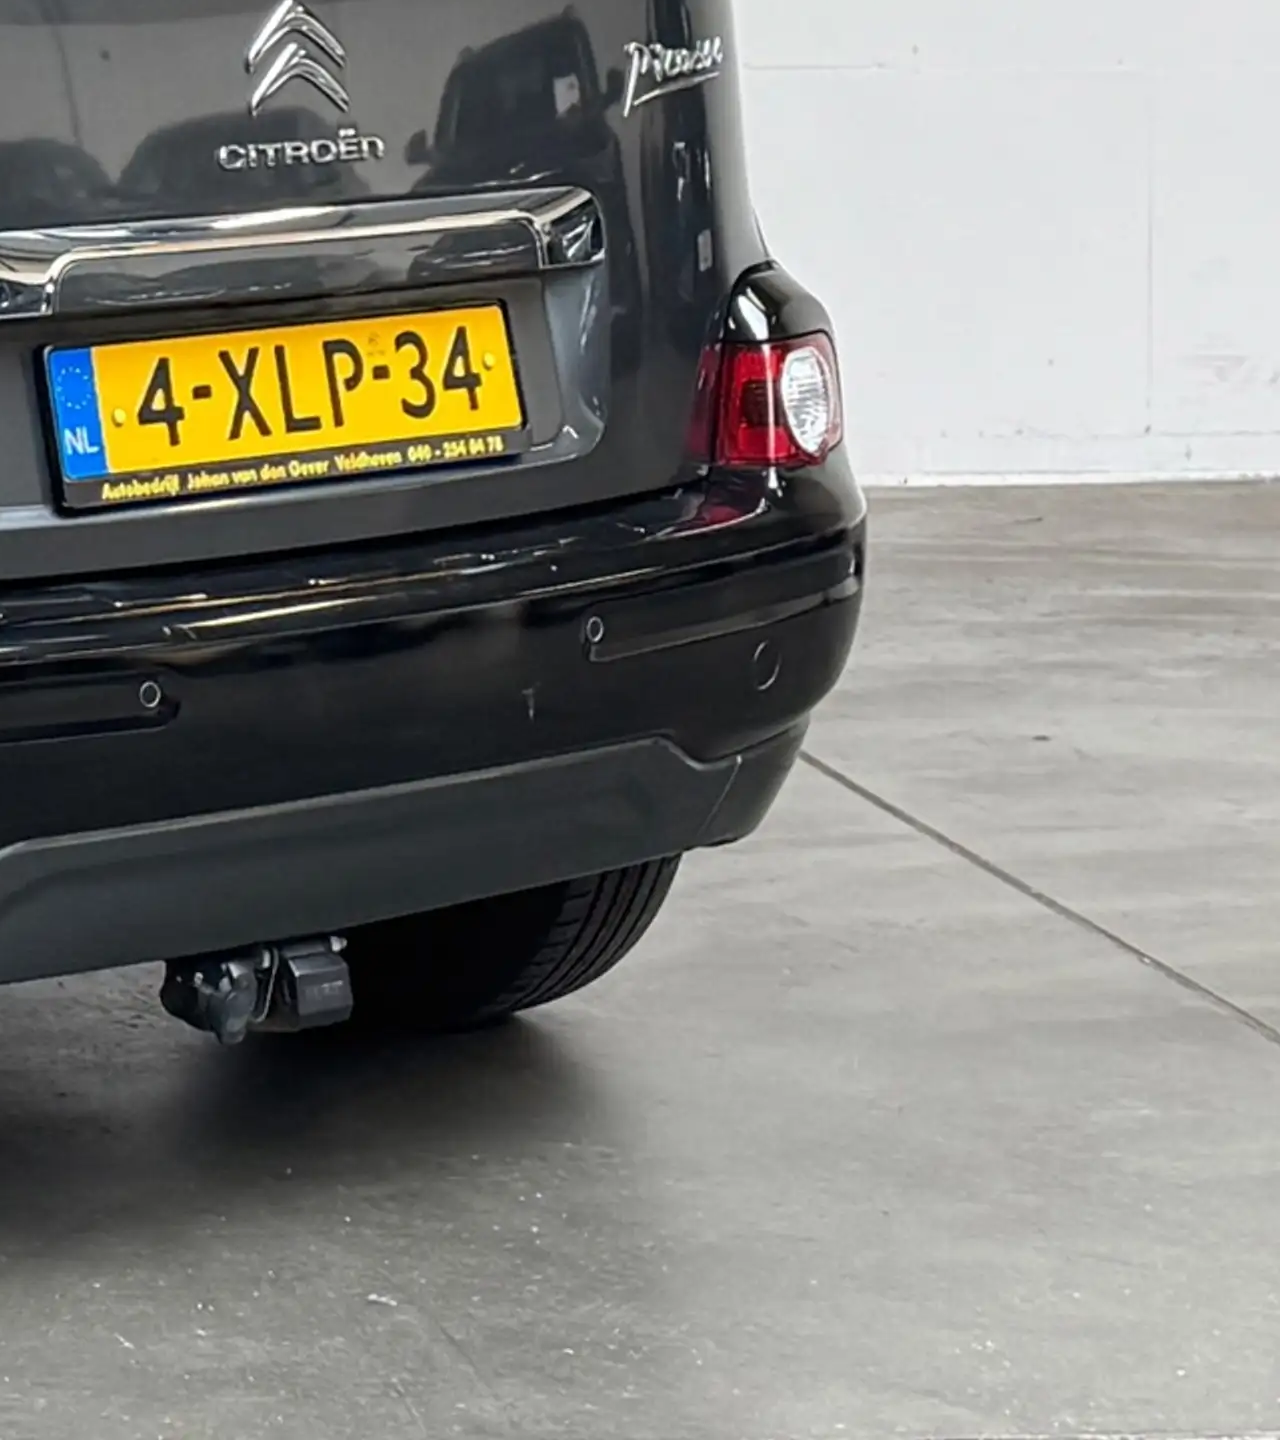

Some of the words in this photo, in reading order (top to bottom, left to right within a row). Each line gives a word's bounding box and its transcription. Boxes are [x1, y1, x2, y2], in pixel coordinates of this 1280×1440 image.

[218, 127, 386, 170] CITROËN
[137, 325, 483, 447] 4-XLP-34
[63, 425, 100, 456] NL
[187, 470, 230, 491] Johan
[231, 467, 258, 483] van
[260, 463, 287, 481] den
[334, 450, 403, 472] Veldhoven
